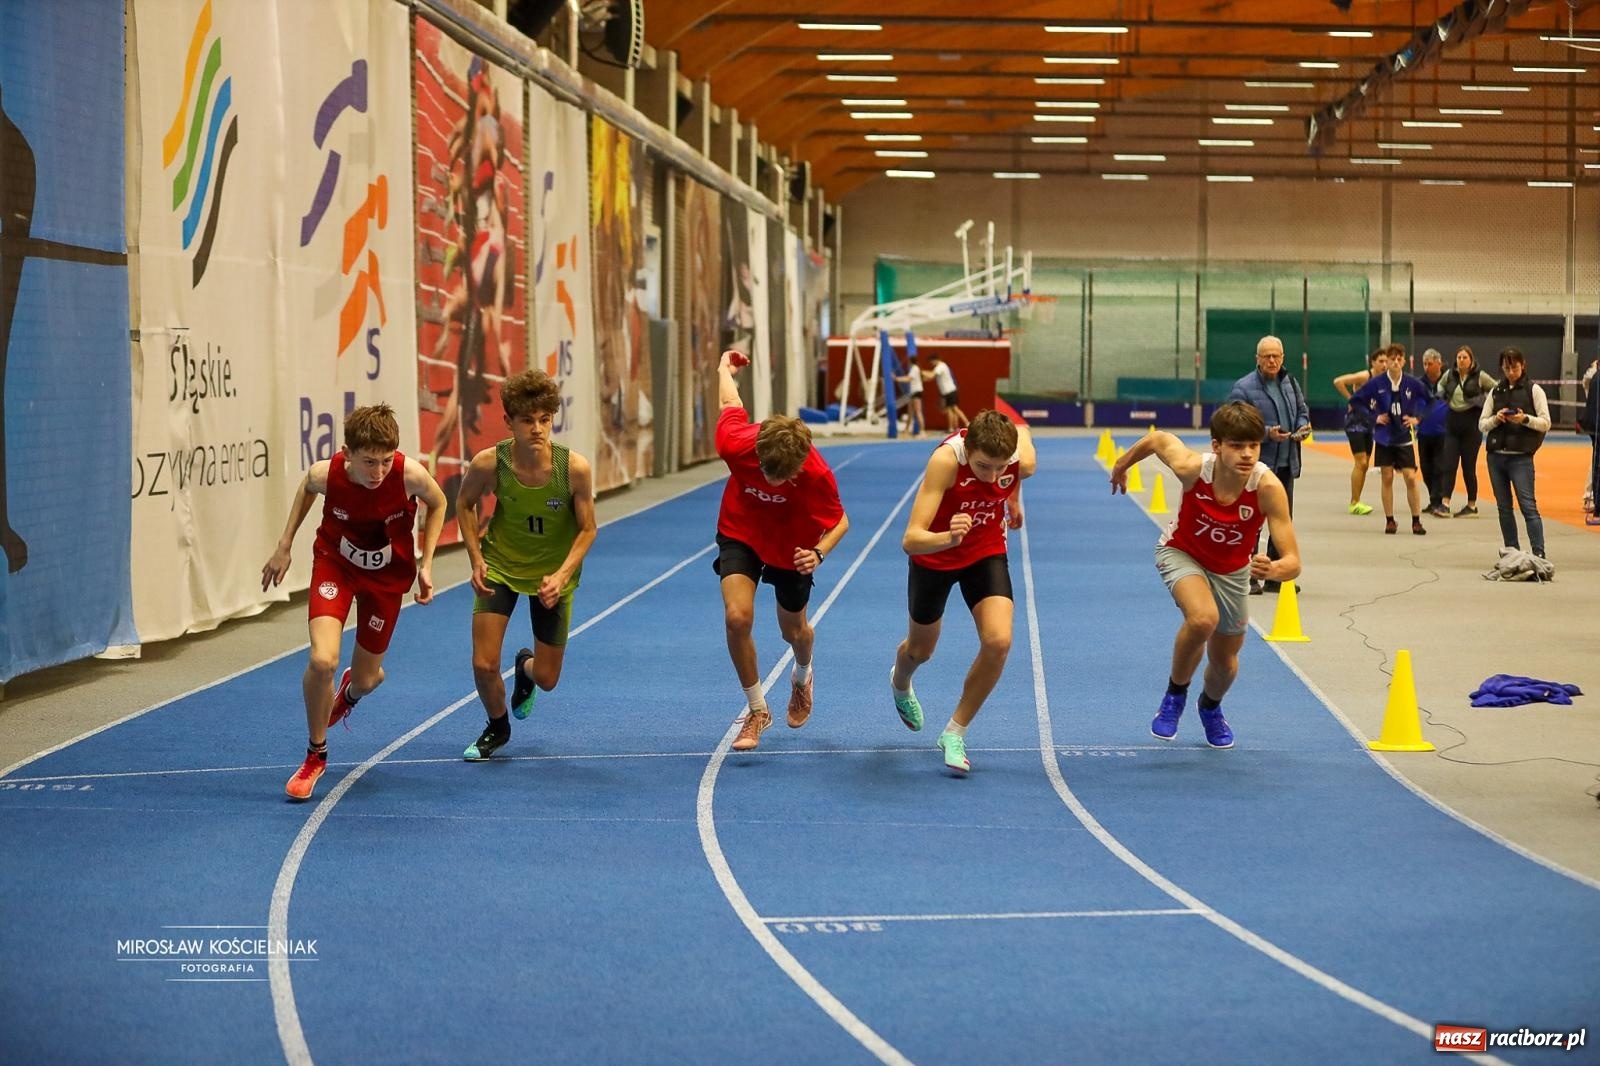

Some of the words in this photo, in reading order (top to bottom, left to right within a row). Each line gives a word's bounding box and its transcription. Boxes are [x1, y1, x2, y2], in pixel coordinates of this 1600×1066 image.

[526, 515, 544, 535] 11
[1194, 519, 1243, 546] 762
[347, 543, 384, 567] 719
